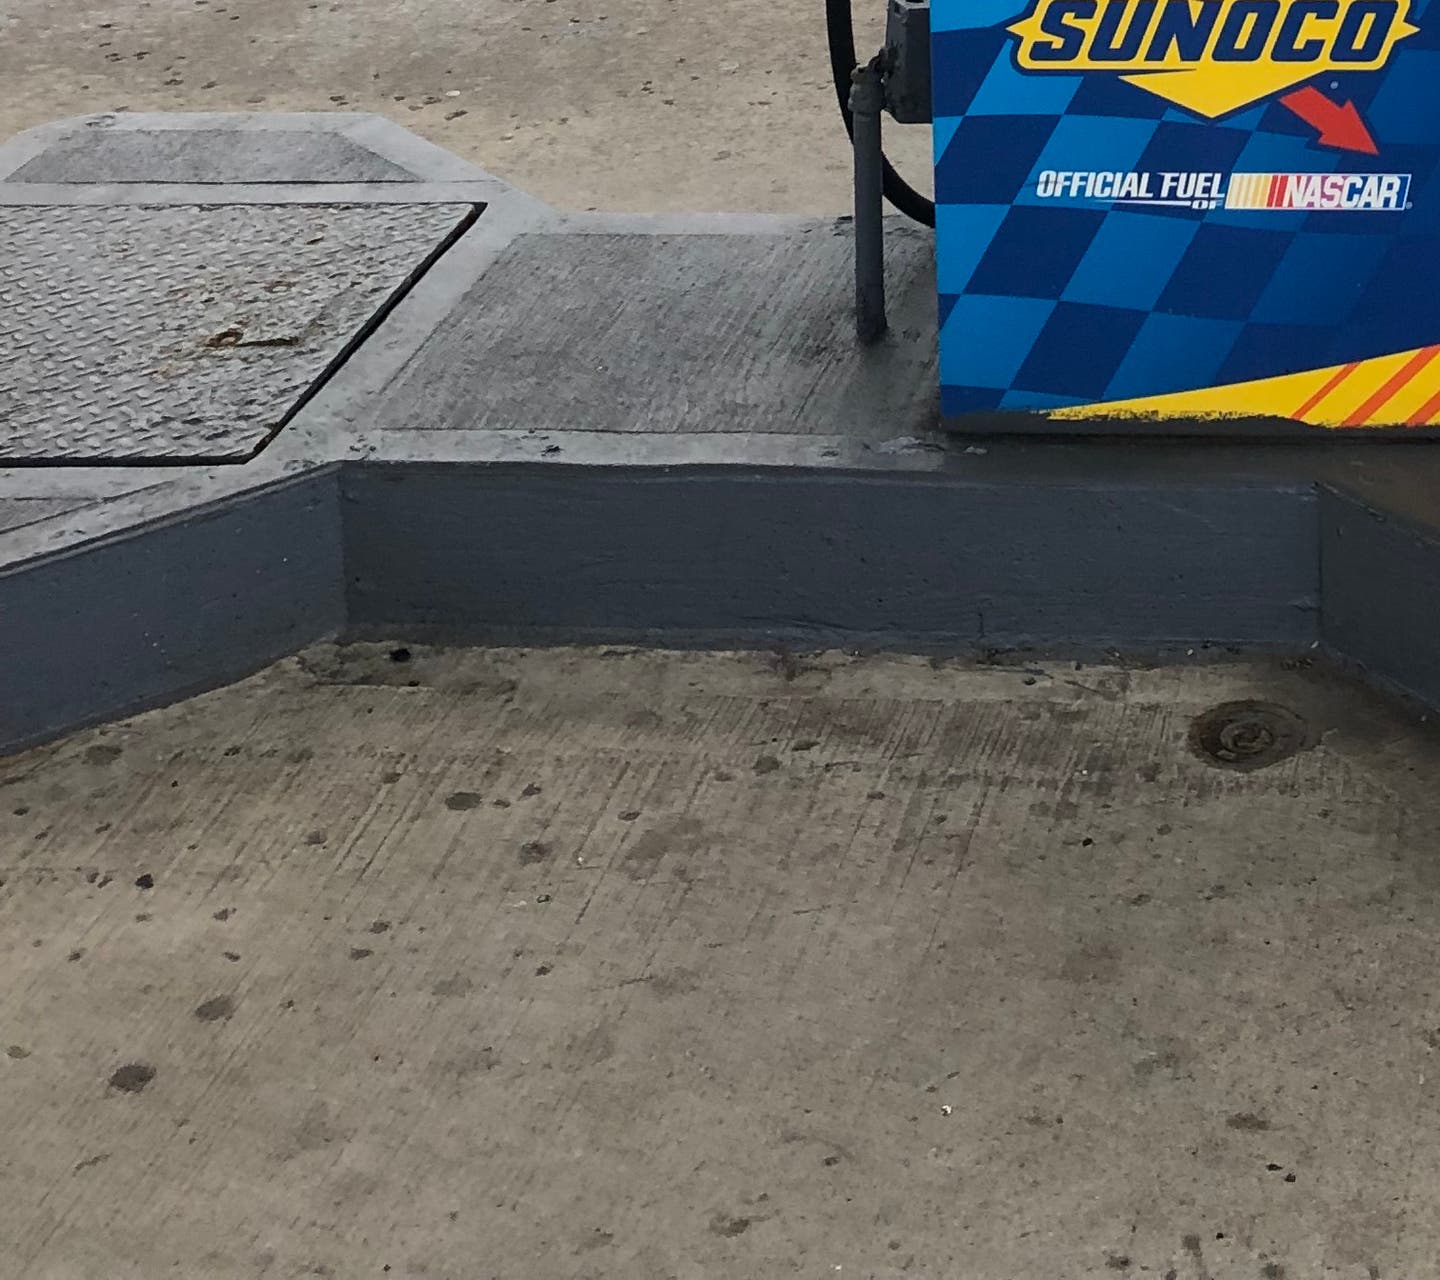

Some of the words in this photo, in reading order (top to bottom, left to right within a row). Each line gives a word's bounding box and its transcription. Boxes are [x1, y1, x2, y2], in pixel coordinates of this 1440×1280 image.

[1036, 170, 1154, 198] OFFICIAL
[1157, 171, 1225, 198] FUEL
[1285, 175, 1400, 208] NASCAR
[1192, 200, 1224, 210] OF
